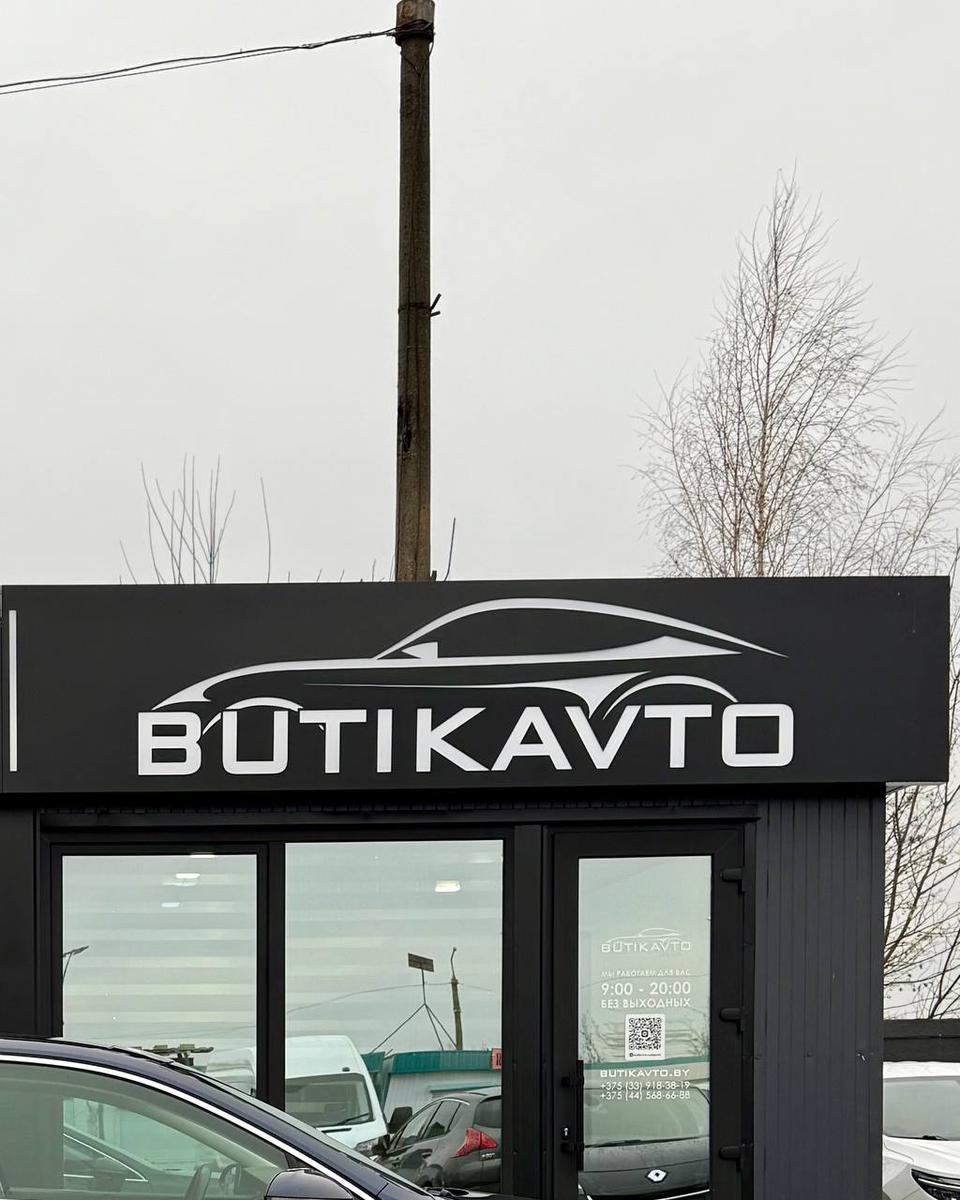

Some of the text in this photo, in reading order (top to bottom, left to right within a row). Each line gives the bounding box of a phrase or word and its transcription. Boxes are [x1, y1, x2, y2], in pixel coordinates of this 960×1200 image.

[138, 703, 794, 776] BUTIKAVTO
[601, 941, 691, 953] BUTIKAVTO
[601, 982, 633, 996] 9:00
[649, 981, 691, 995] 20:00
[601, 998, 691, 1009] БЕЗ ВЫХОДНЫХ
[600, 1069, 690, 1078] BUTIKAVTO.BY
[600, 1081, 691, 1092] +375 (33) 918-38-19
[600, 1091, 691, 1101] +375 (44) 568-66-88
